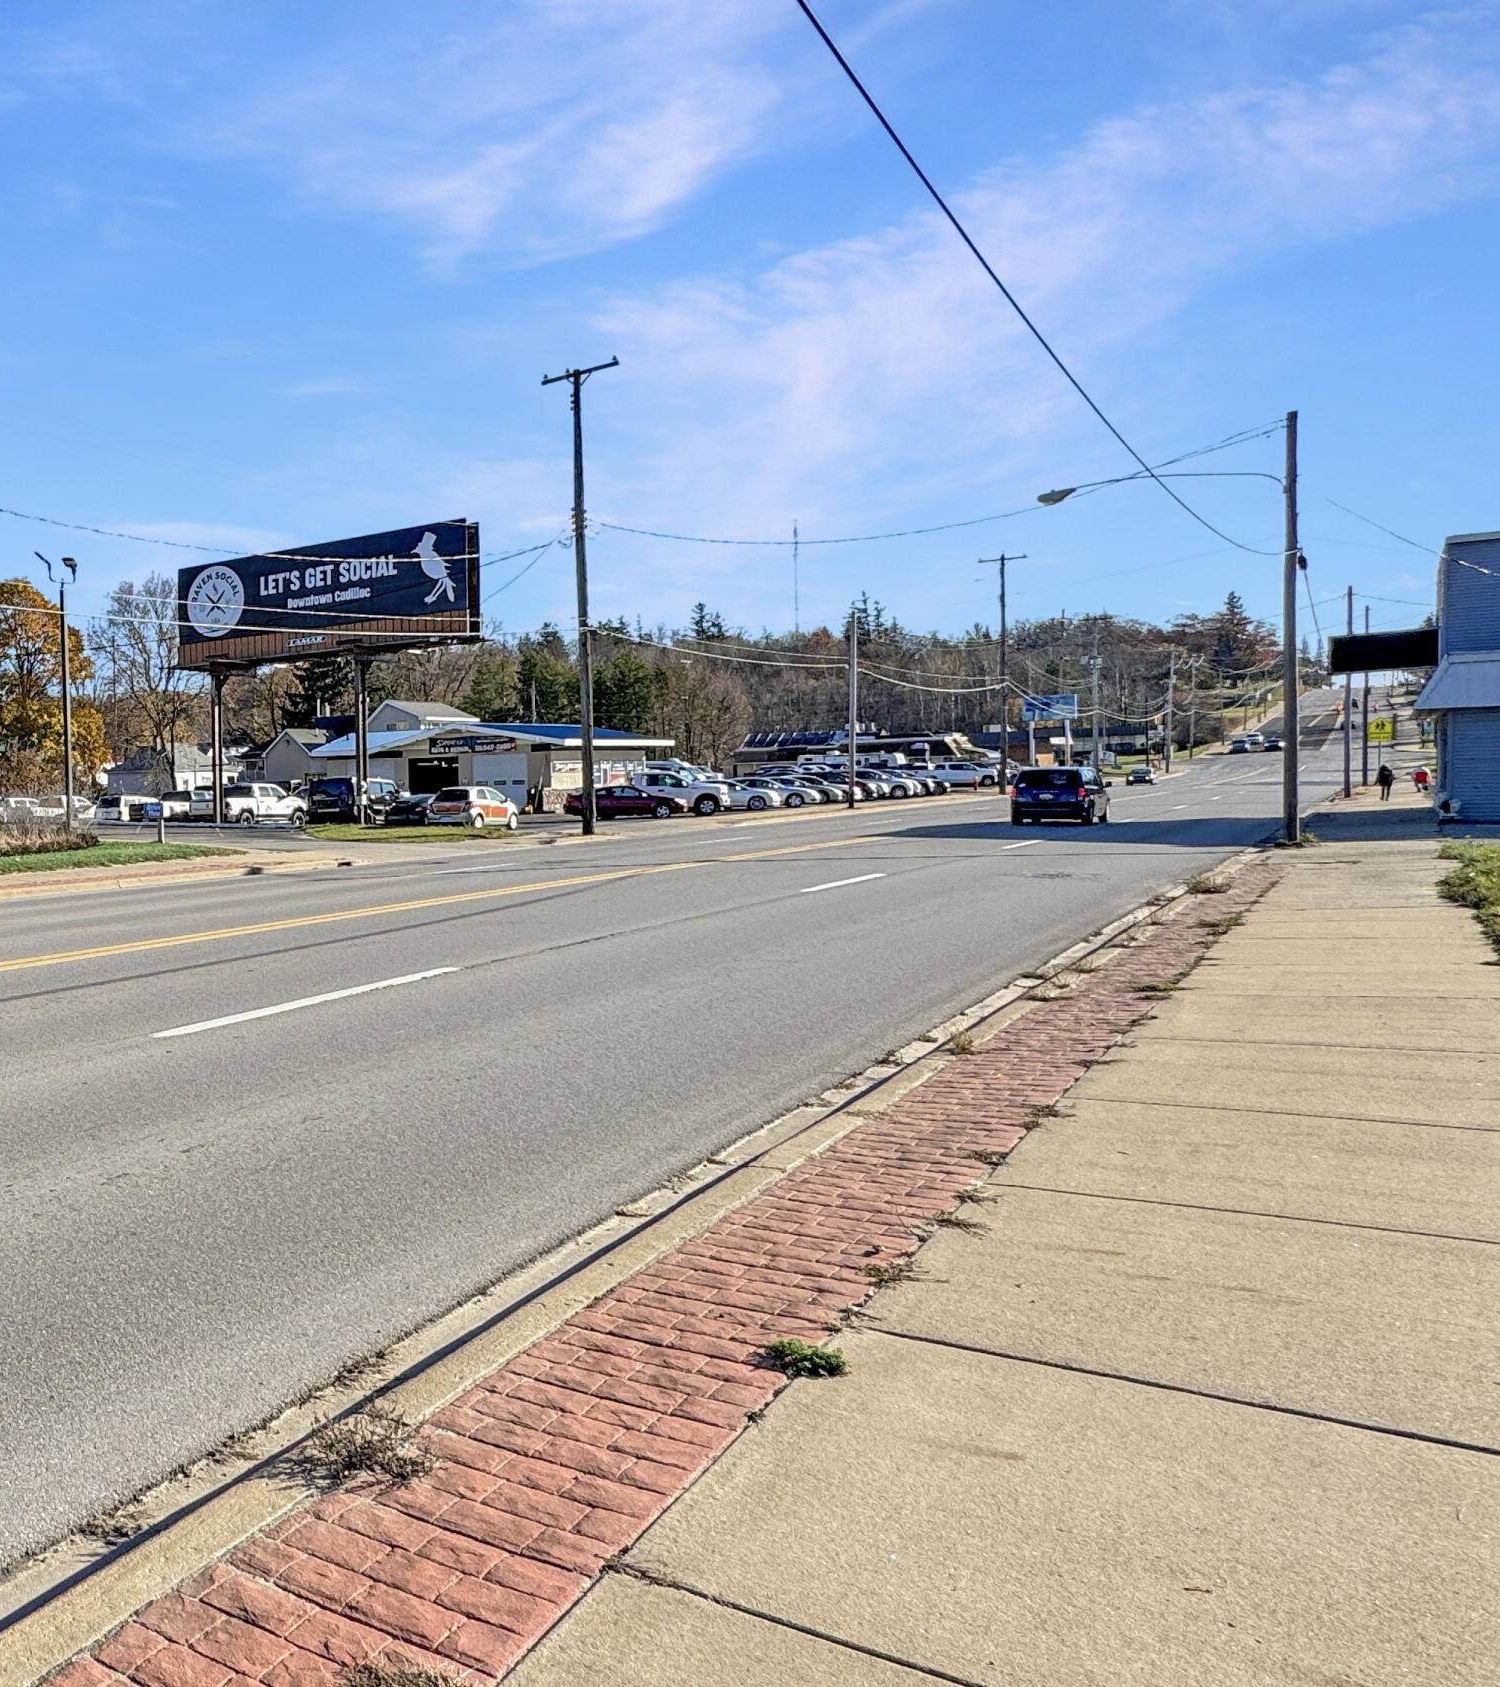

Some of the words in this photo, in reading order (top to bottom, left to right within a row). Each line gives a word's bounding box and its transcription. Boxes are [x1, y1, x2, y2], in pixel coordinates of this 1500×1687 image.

[191, 572, 213, 603] RAVEN
[214, 571, 240, 598] SOCIAL
[260, 570, 301, 596] LET'S
[304, 564, 335, 589] GET
[339, 555, 398, 583] SOCIAL
[287, 593, 333, 609] Downtown
[334, 587, 371, 602] Cadillac
